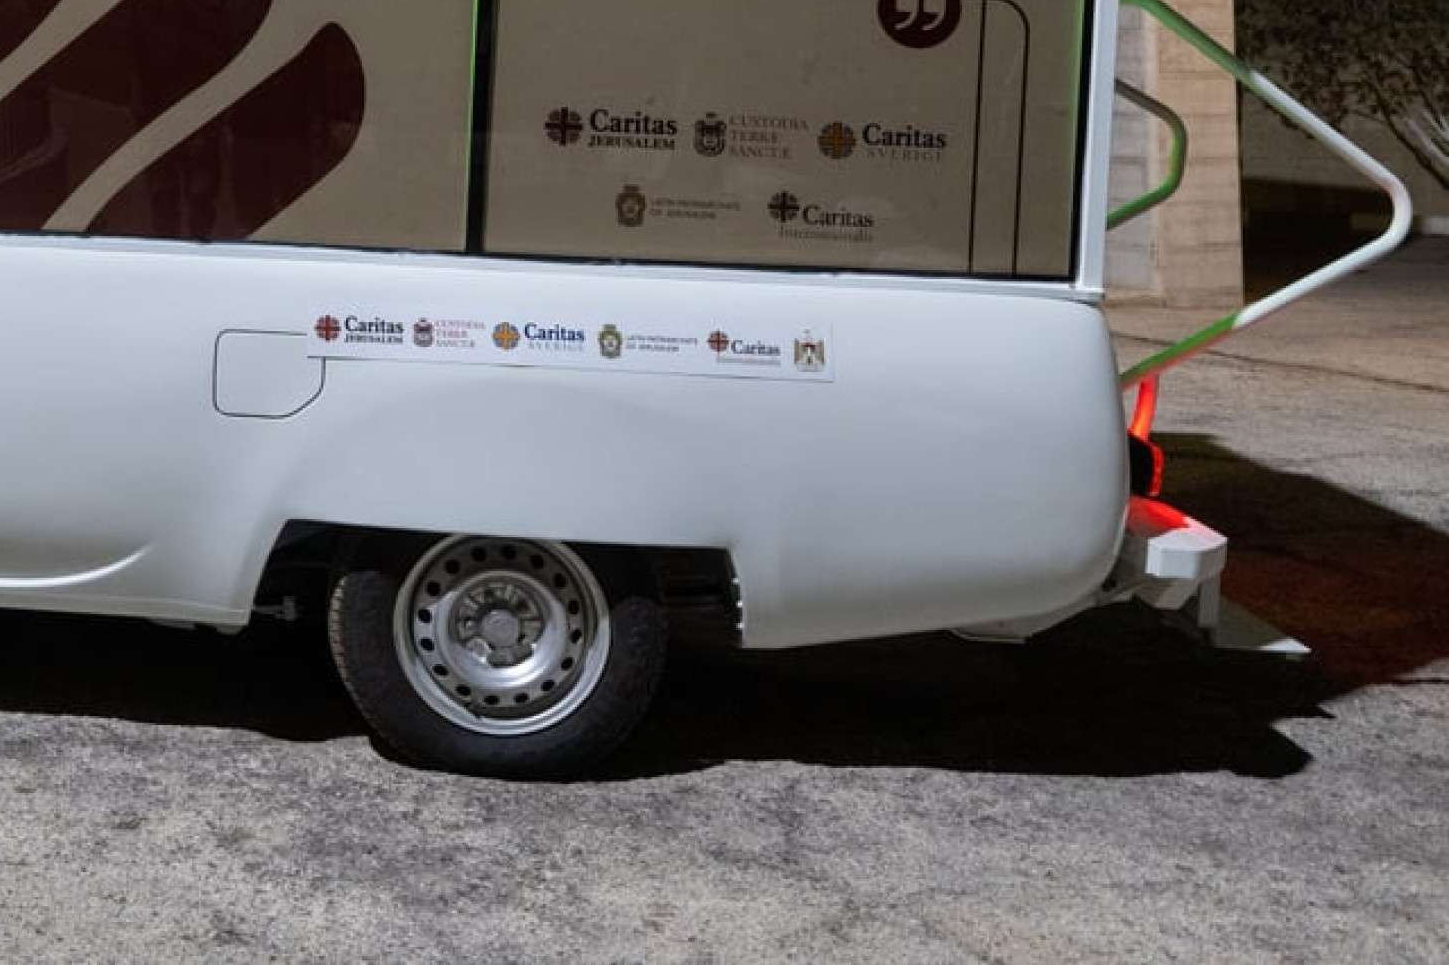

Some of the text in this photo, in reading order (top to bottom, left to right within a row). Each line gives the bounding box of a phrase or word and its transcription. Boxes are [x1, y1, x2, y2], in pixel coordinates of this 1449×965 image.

[589, 107, 678, 137] Caritas
[588, 135, 676, 151] JERUSALEM
[861, 122, 947, 149] Caritas
[802, 205, 875, 228] Caritas
[345, 314, 405, 334] Caritas
[524, 322, 585, 341] Caritas
[731, 339, 781, 356] Caritas
